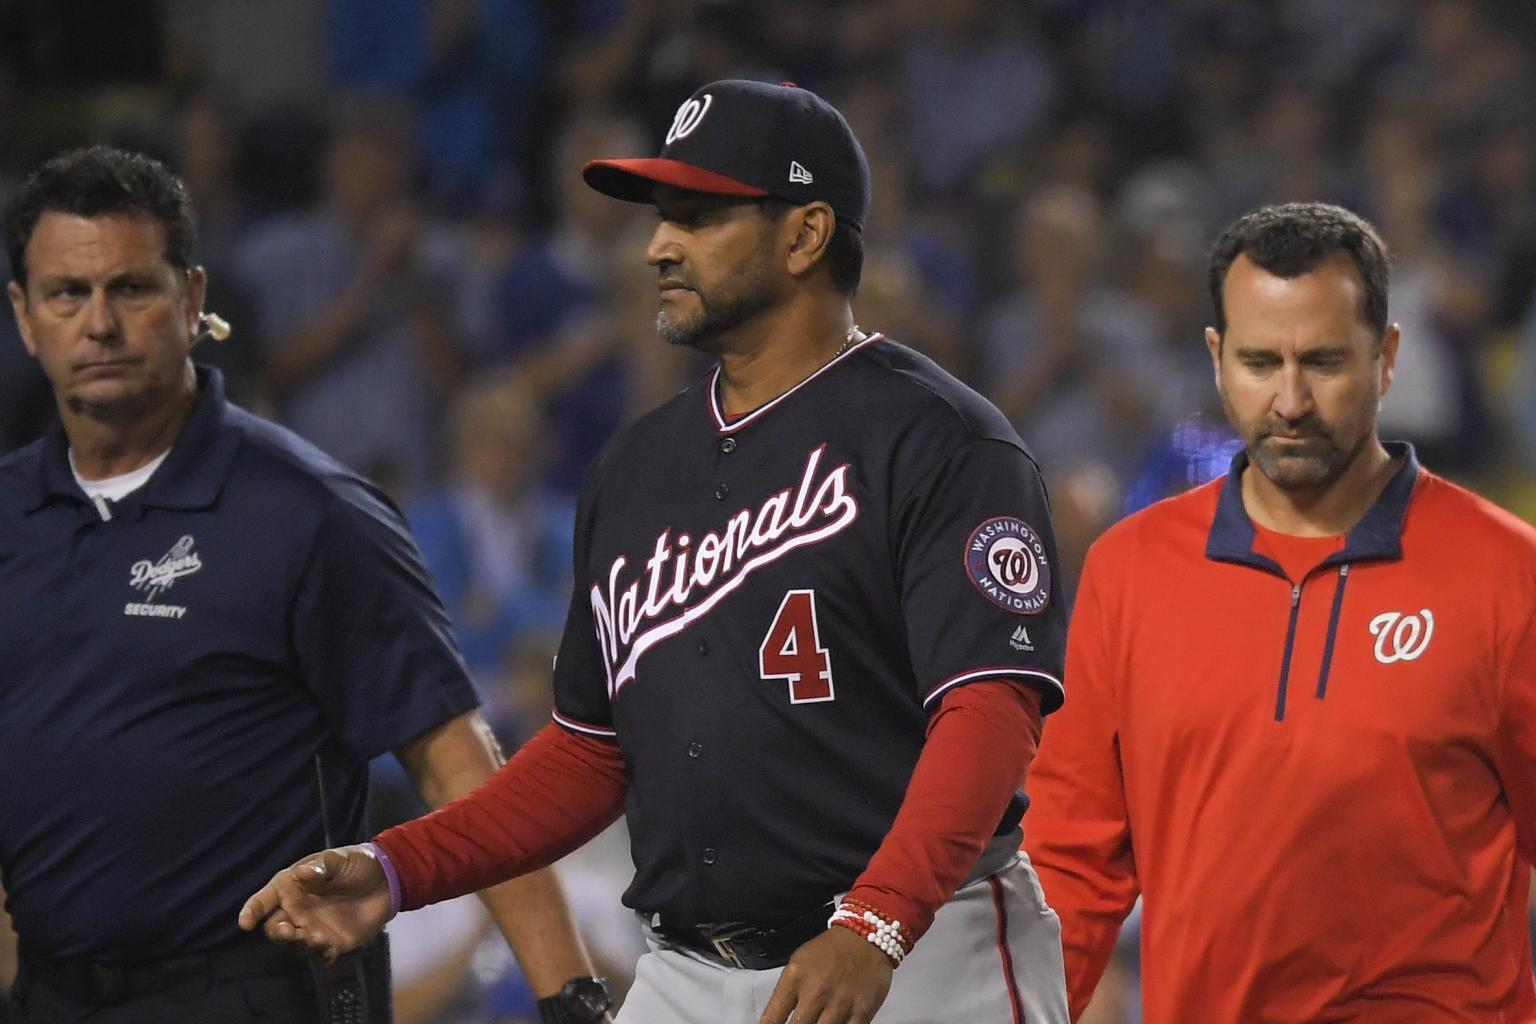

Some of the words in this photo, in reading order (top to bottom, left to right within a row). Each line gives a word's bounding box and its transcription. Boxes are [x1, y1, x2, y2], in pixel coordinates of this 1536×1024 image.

[665, 93, 713, 145] W
[972, 520, 1047, 566] WASHINGTON
[128, 552, 203, 587] Dodgers
[590, 442, 857, 701] Nationals
[993, 547, 1032, 587] W
[124, 602, 187, 618] SECURITY
[979, 576, 1048, 610] NATIONALS
[759, 589, 835, 704] 4
[1368, 608, 1434, 664] W
